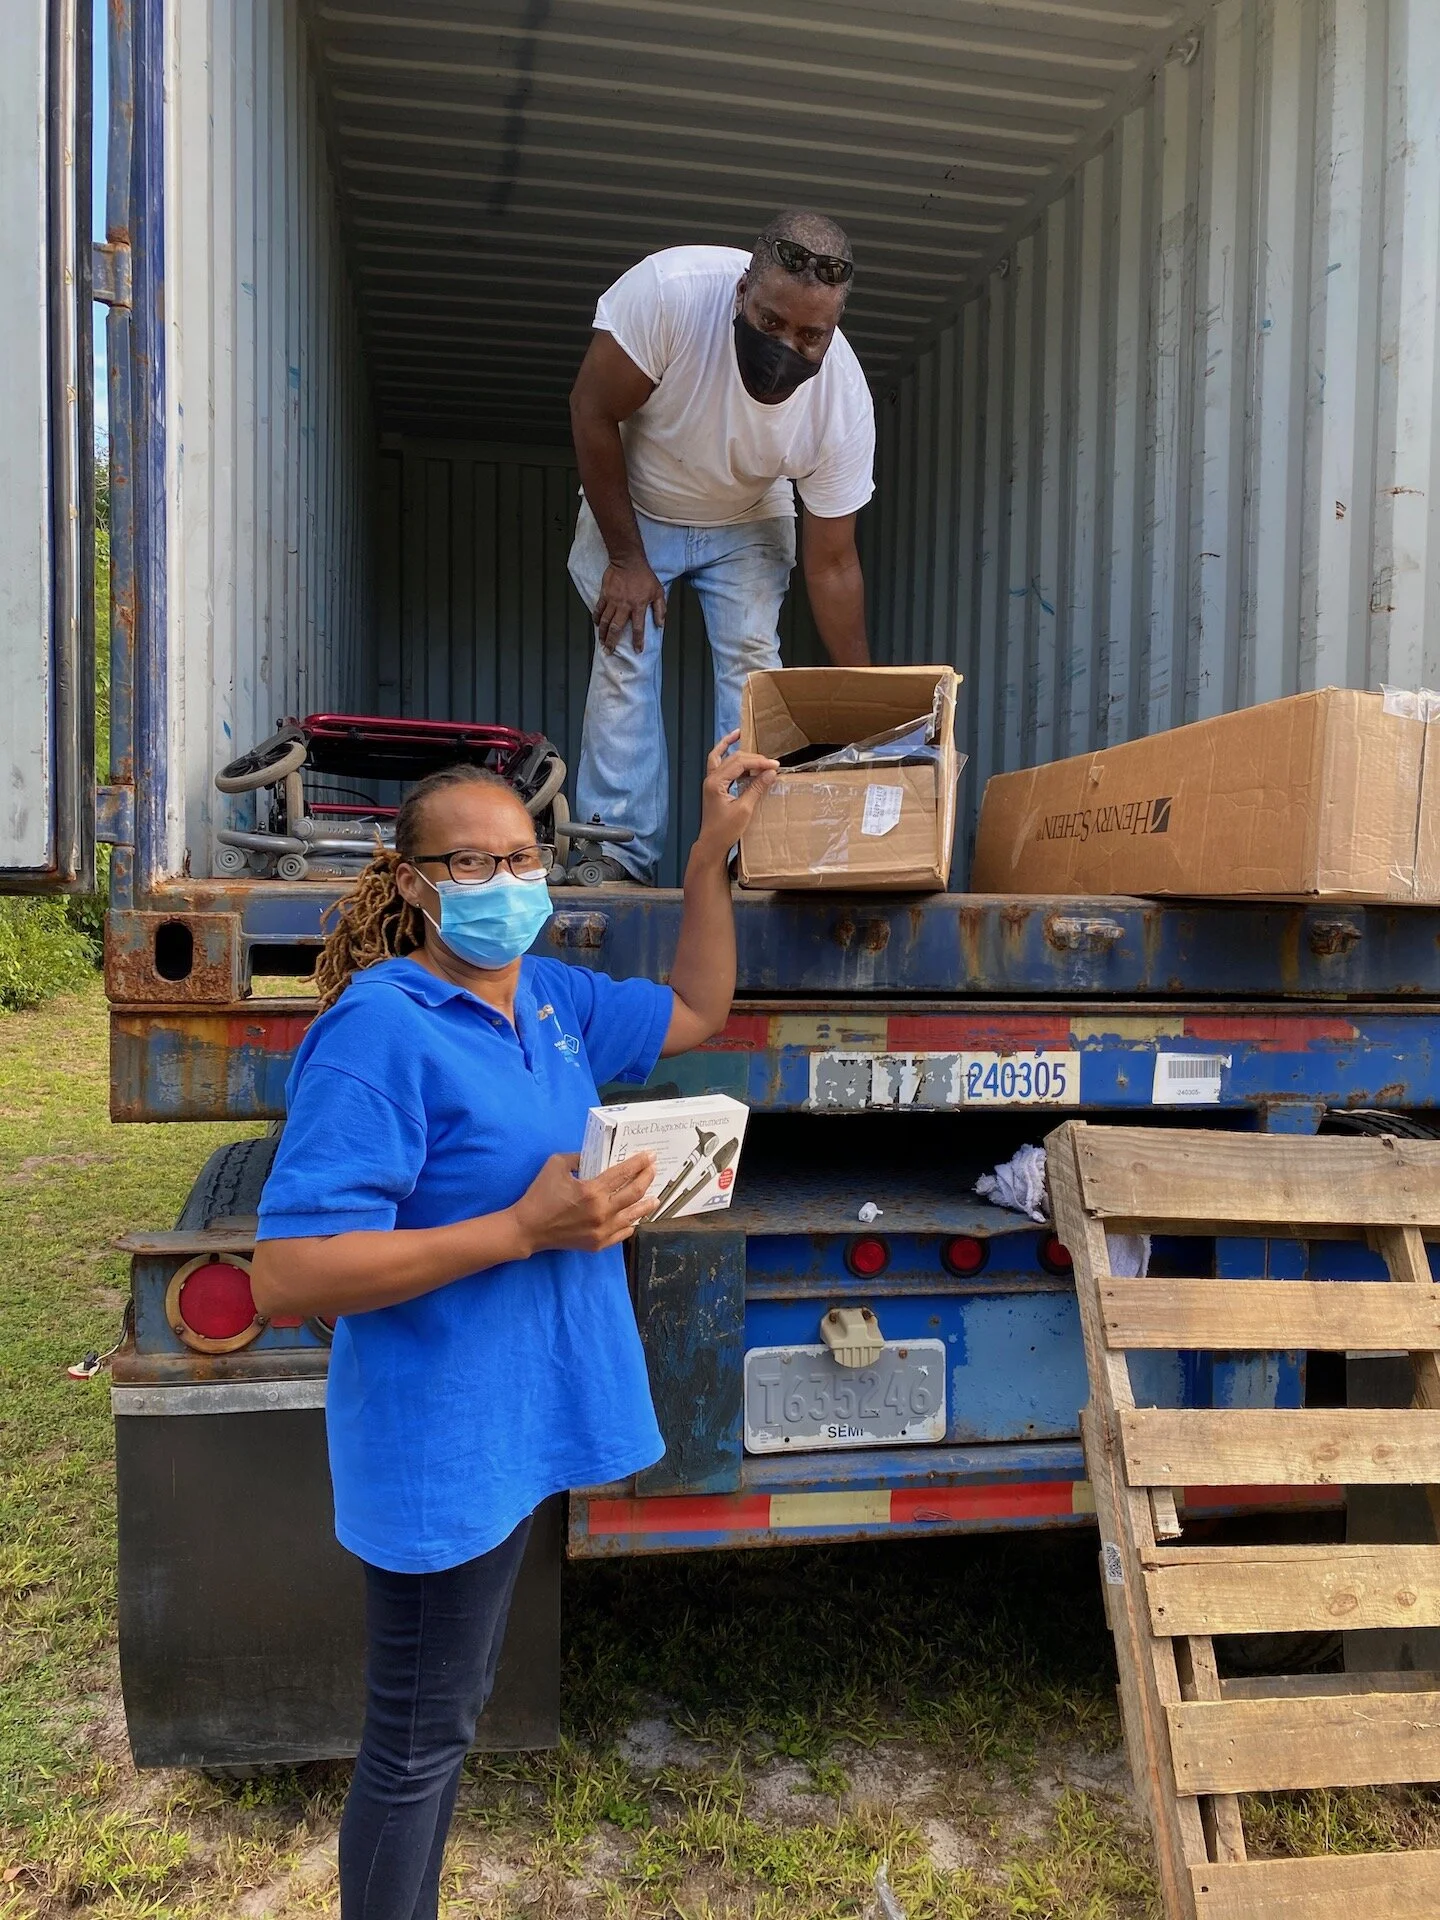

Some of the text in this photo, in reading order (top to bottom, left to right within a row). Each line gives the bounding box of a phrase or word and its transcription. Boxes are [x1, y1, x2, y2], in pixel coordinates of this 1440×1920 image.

[1090, 799, 1154, 836] HENRY
[969, 1061, 1067, 1099] 240305
[622, 1117, 730, 1136] Pocket Diagnostic Instruments
[757, 1369, 933, 1424] T635246
[827, 1425, 864, 1439] SEMI
